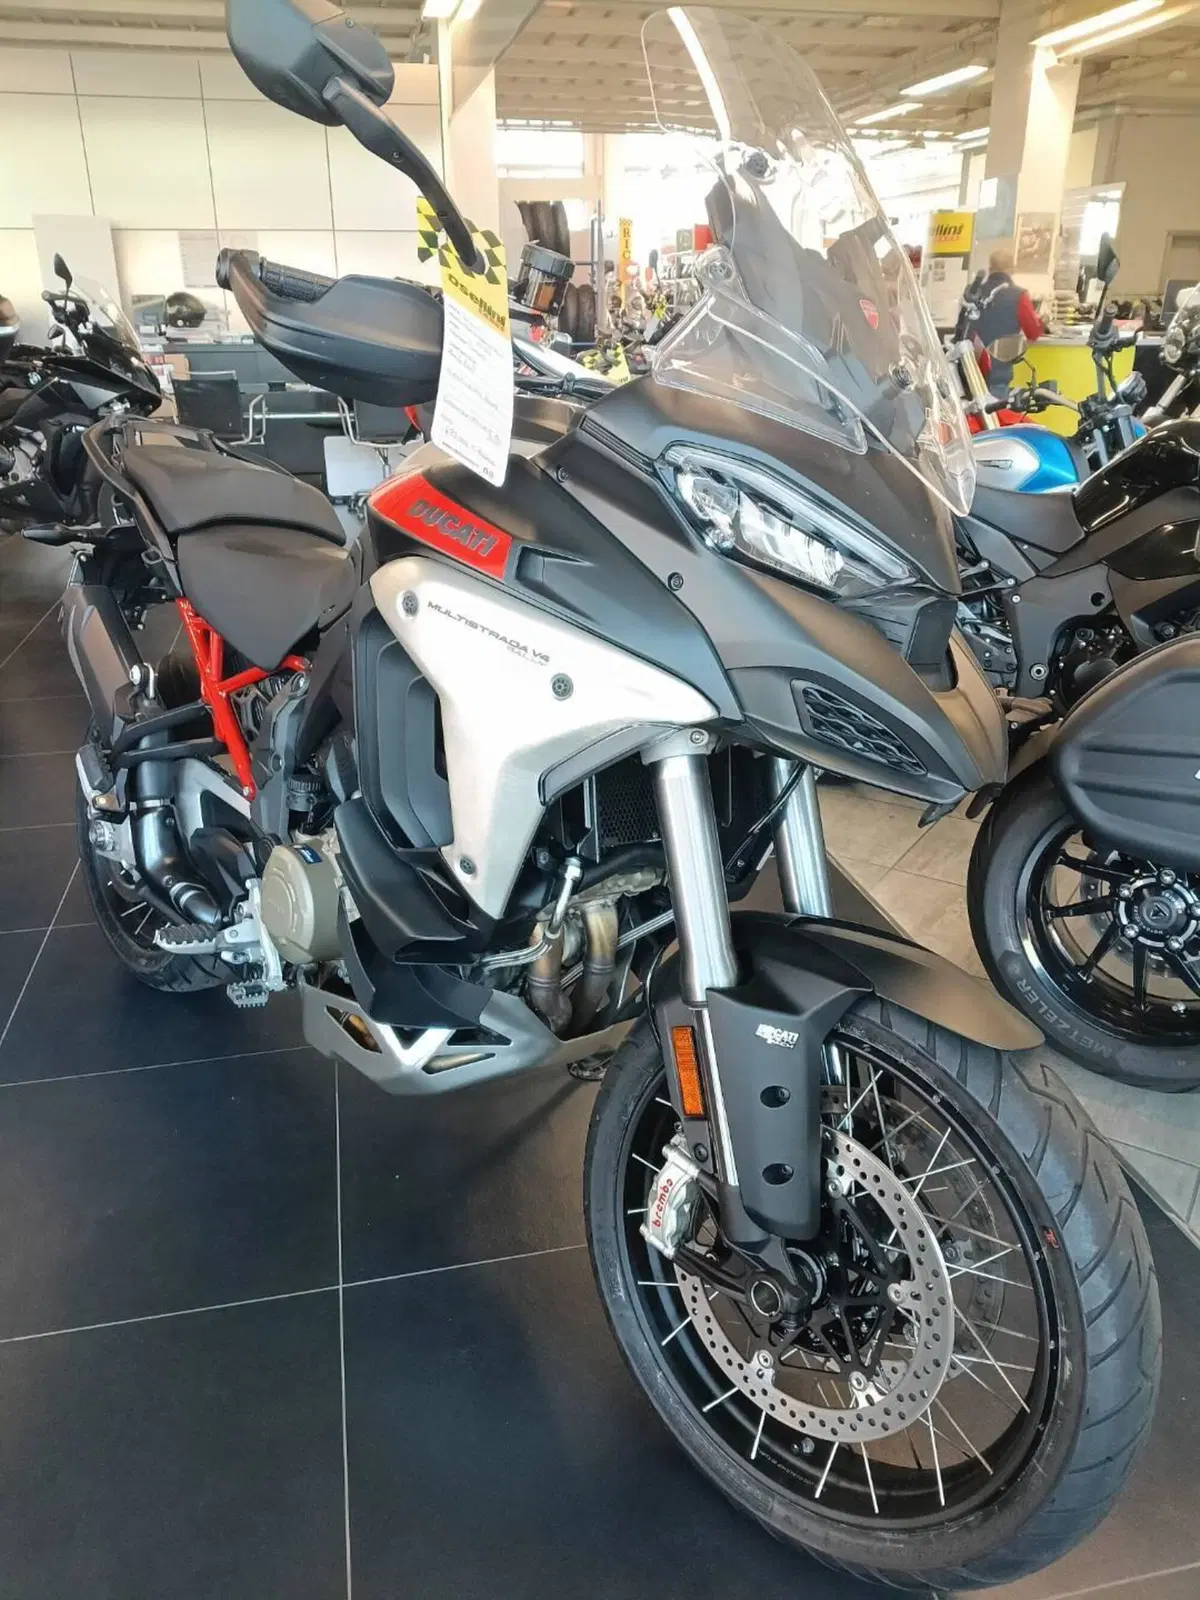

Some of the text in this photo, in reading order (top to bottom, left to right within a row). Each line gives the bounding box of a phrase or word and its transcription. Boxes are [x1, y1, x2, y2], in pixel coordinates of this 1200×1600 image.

[408, 499, 499, 557] DUCATI
[427, 600, 551, 662] MULTISTRADA V4
[1016, 978, 1113, 1058] METZELER
[651, 1178, 674, 1228] brembo
